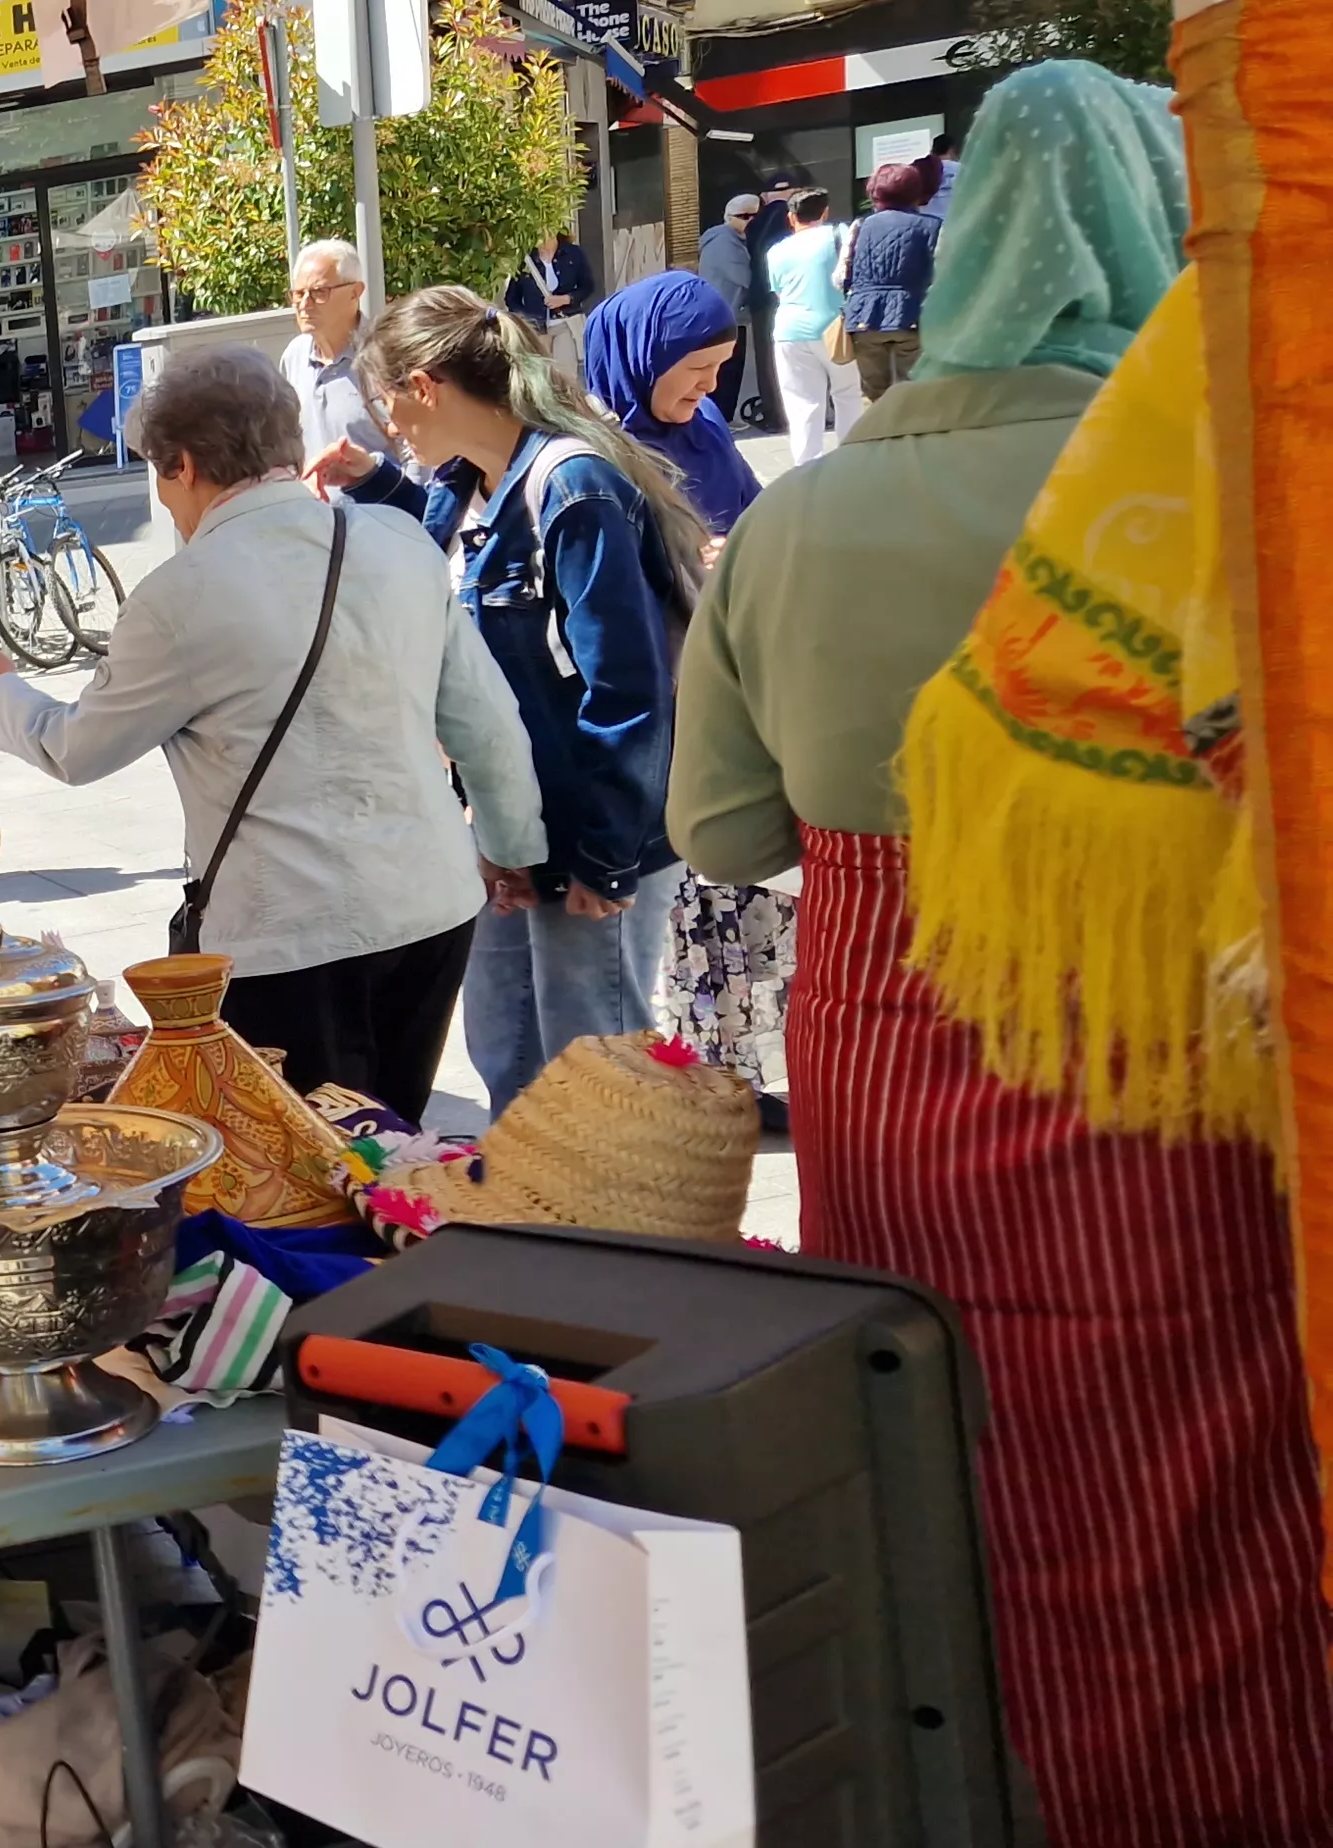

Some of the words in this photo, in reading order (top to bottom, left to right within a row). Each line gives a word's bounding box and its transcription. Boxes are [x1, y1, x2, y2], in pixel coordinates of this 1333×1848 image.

[576, 3, 610, 17] The
[577, 13, 630, 31] one
[634, 14, 678, 57] CASO
[2, 59, 28, 70] Venta
[351, 1663, 558, 1783] JOLFER
[370, 1732, 453, 1779] JOYEROS
